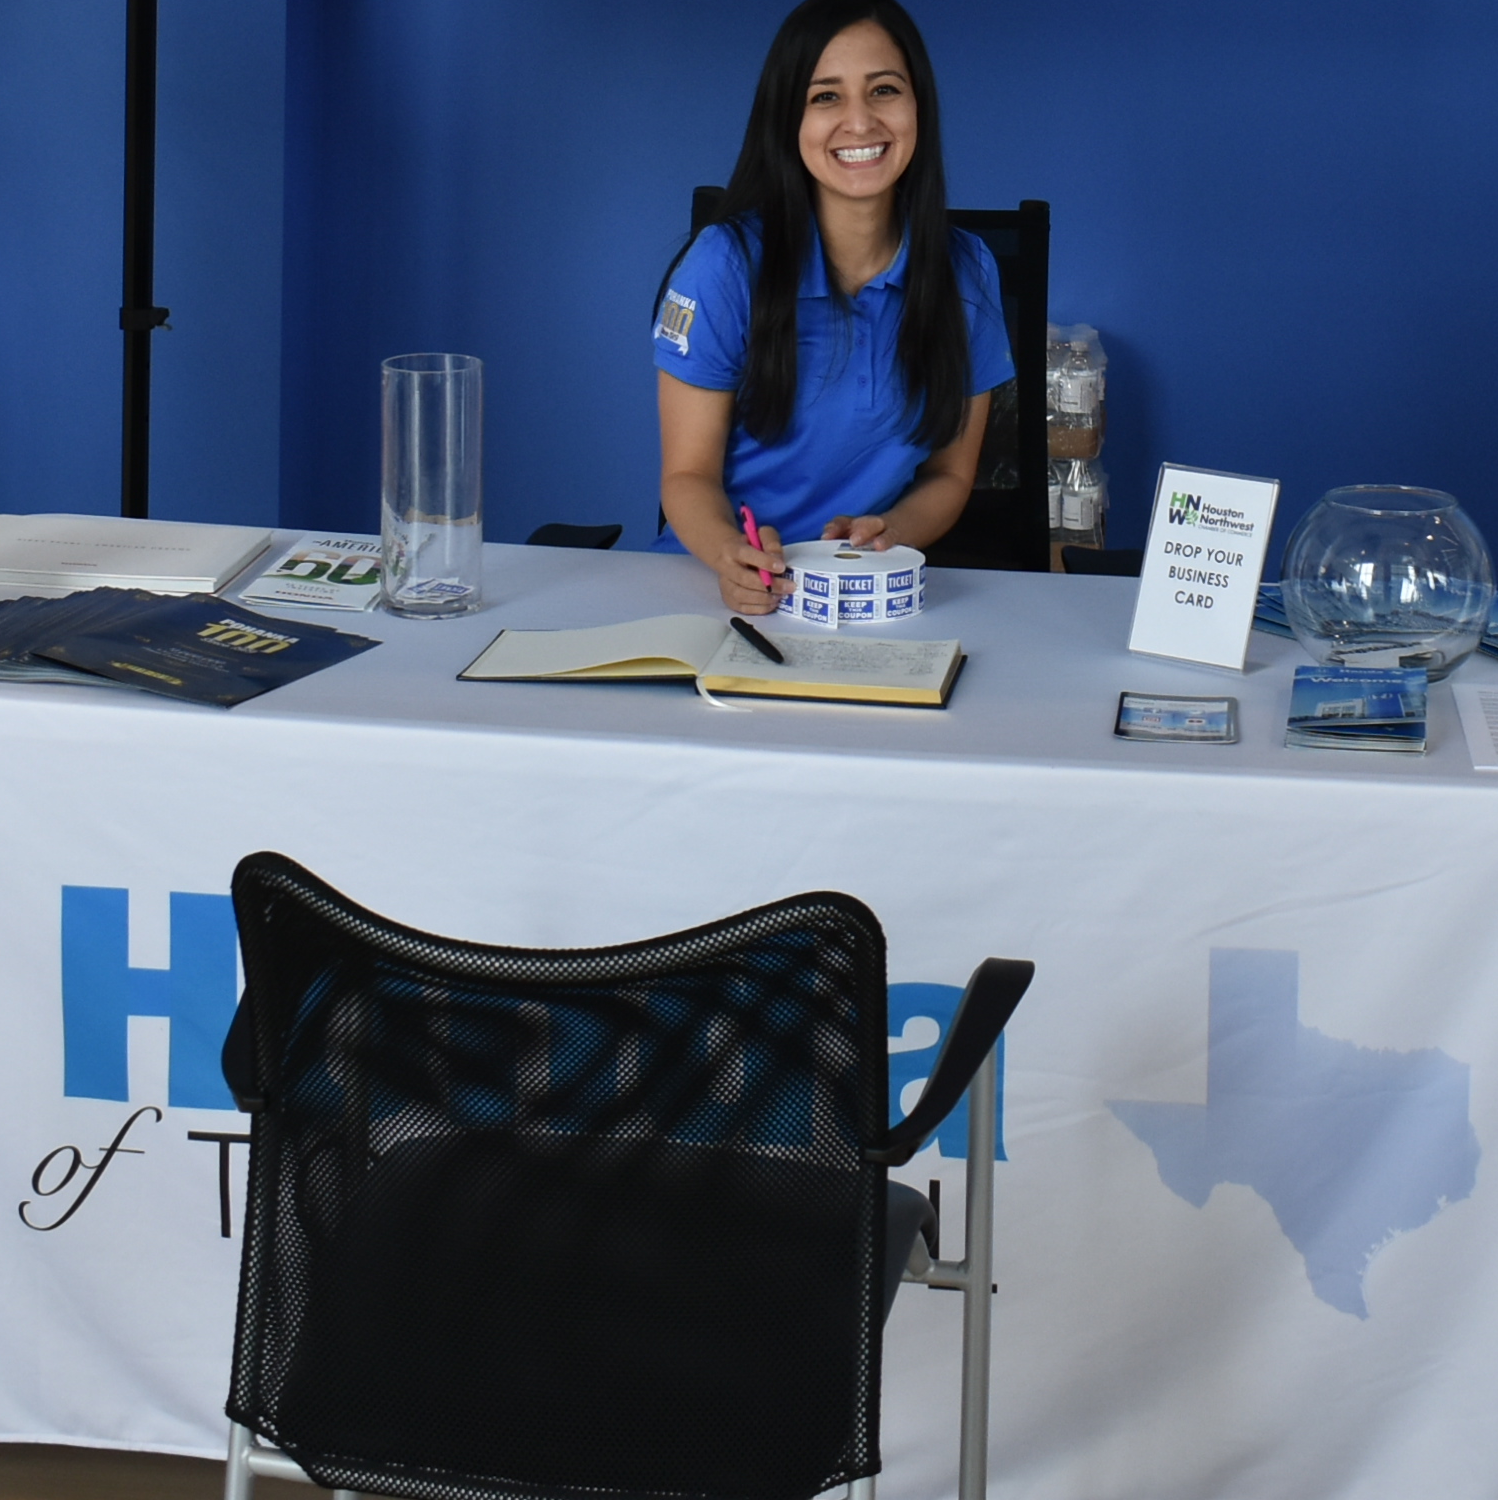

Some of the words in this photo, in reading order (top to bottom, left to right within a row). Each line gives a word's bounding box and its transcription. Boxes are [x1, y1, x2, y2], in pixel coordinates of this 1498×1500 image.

[1201, 503, 1245, 519] Houston
[1199, 513, 1255, 532] Northwest
[1164, 541, 1203, 559] DROP
[1206, 547, 1244, 567] YOUR
[804, 577, 829, 594] TICKET
[839, 579, 873, 591] TICKET
[888, 574, 913, 588] TICKET
[1168, 565, 1230, 589] BUSINESS
[1174, 590, 1214, 609] CARD
[838, 611, 873, 619] COUPON
[16, 1105, 164, 1234] of
